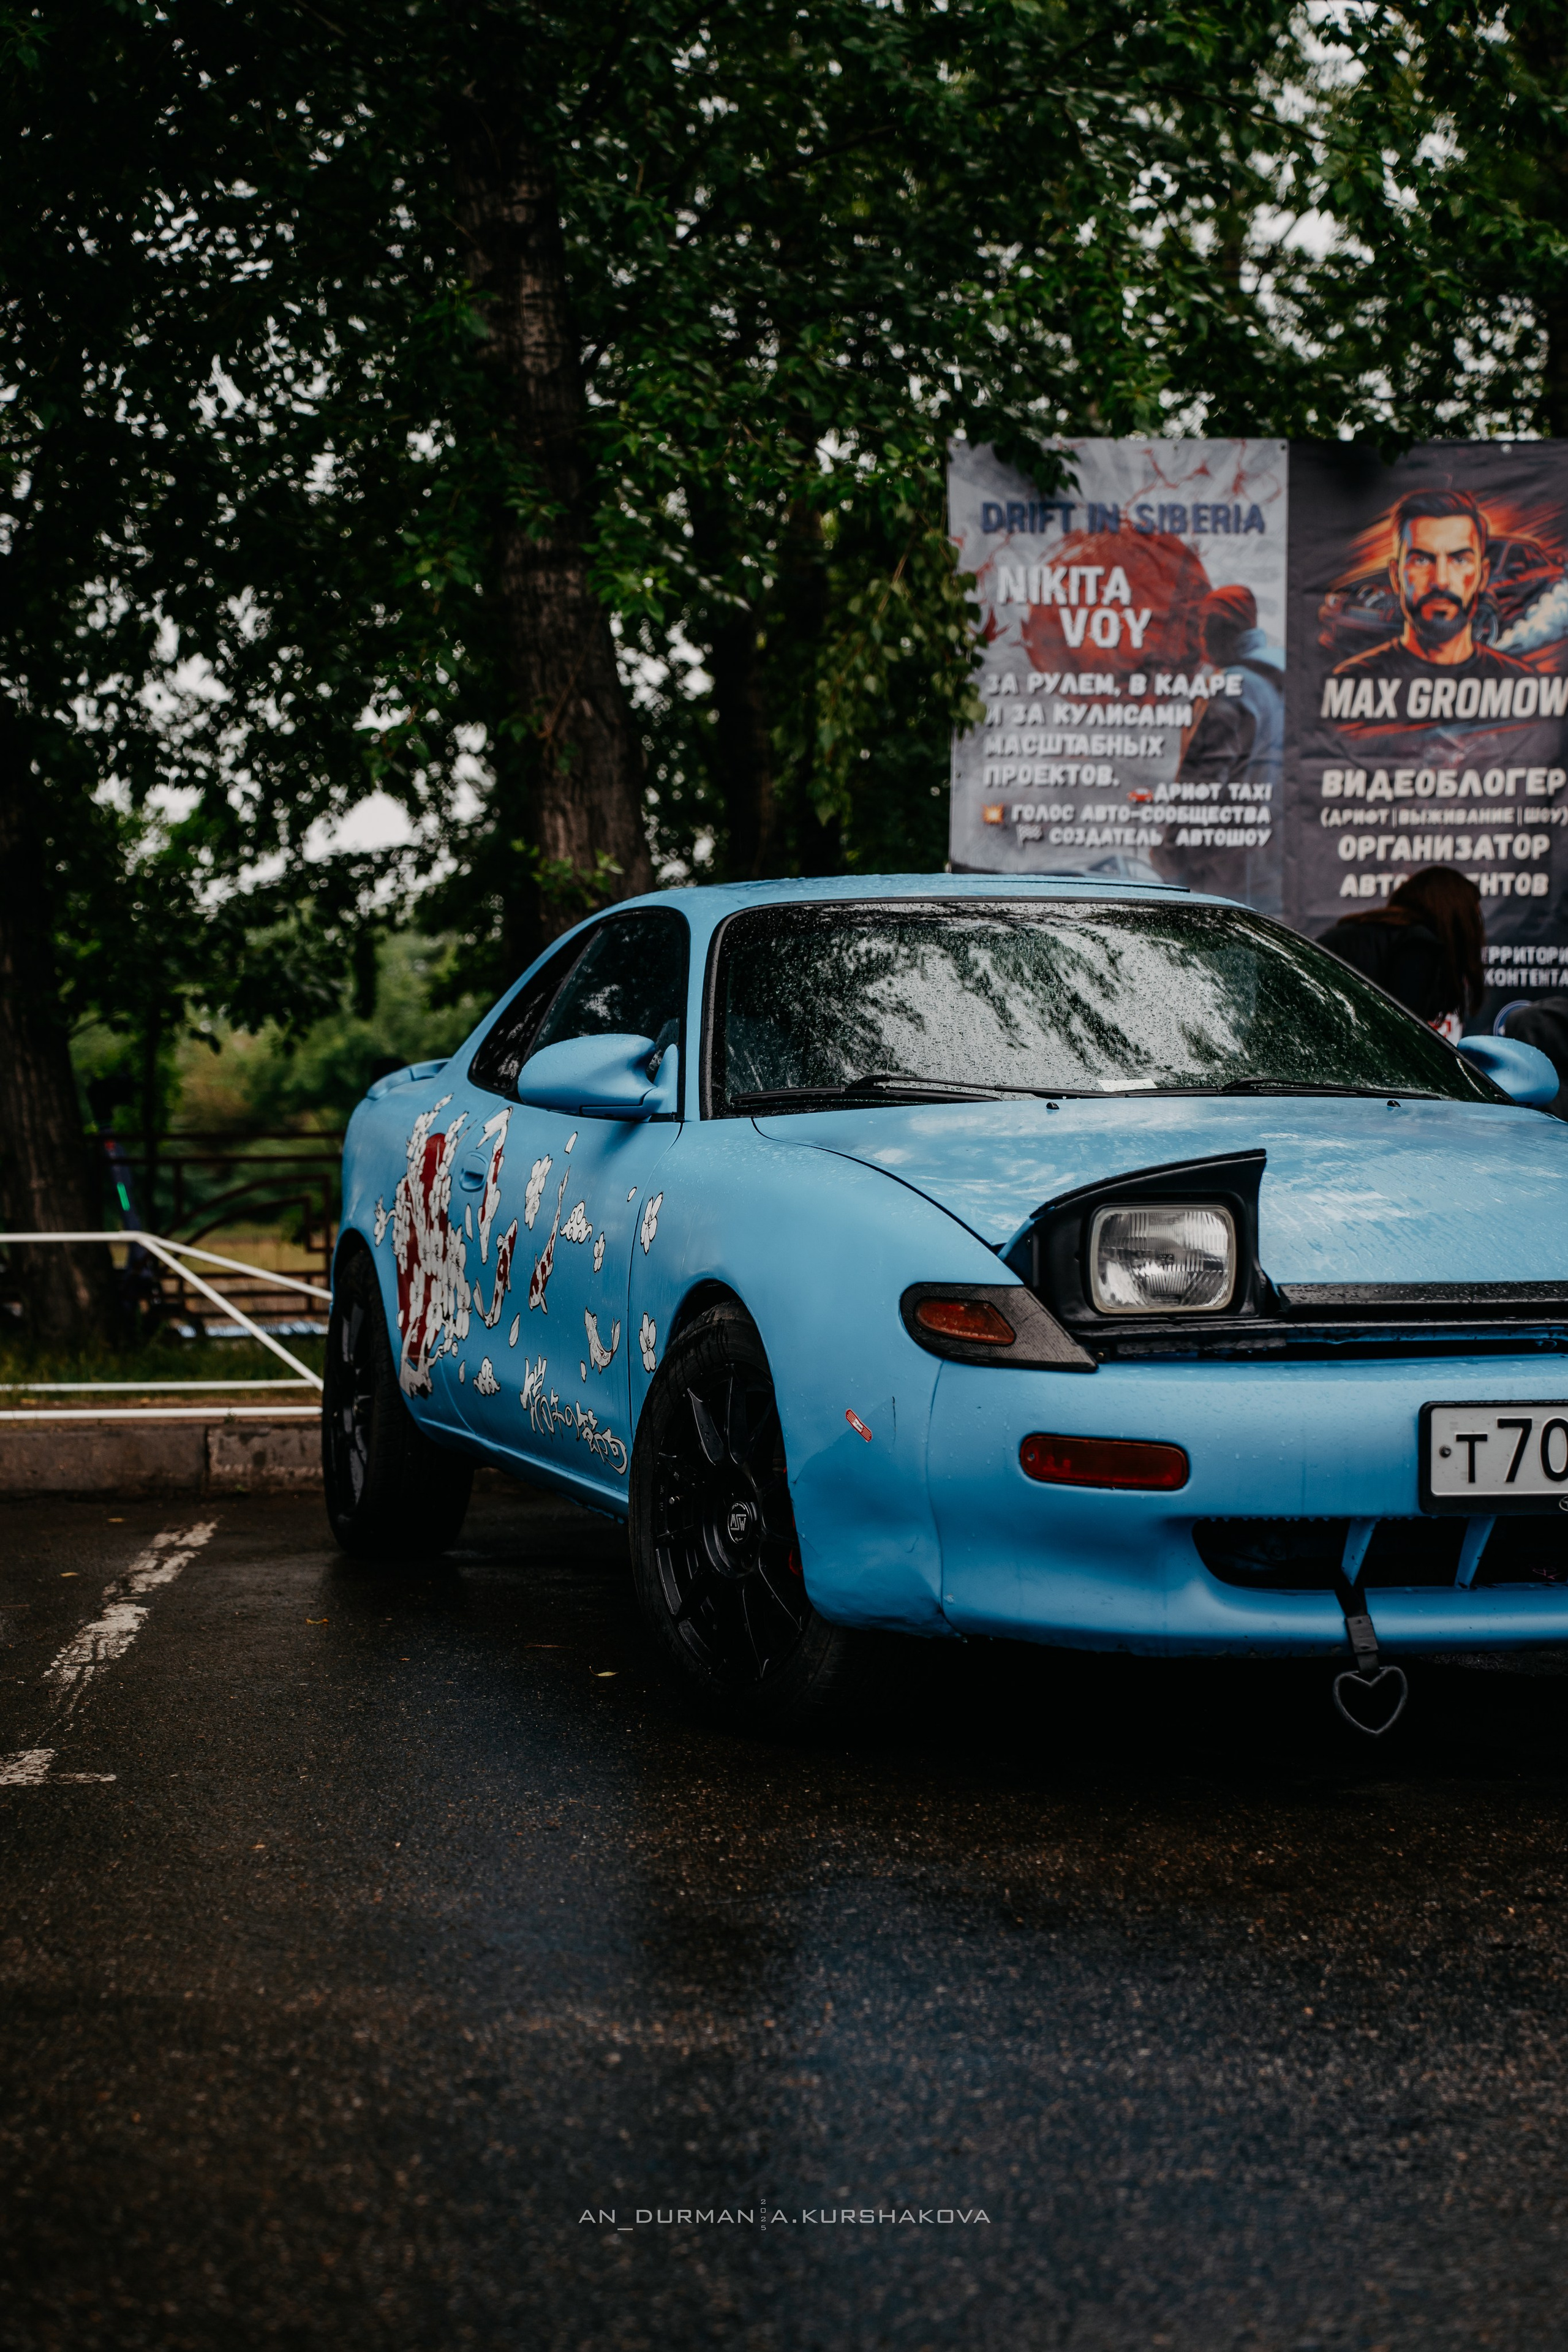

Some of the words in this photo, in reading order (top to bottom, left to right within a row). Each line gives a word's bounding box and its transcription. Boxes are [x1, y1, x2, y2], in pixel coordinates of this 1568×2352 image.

[982, 502, 1076, 533] DRIFT
[1087, 502, 1120, 533] IN
[1136, 503, 1266, 534] SIBERIA
[997, 565, 1131, 605] NIKITA
[1059, 608, 1152, 648] VOY
[987, 674, 1019, 695] ЗА
[1027, 673, 1121, 696] РУЛЕМ,
[1129, 674, 1147, 695] В
[1154, 674, 1242, 699] КАДРЕ
[1321, 677, 1402, 719] MAX
[1406, 676, 1568, 719] GROMOW
[1012, 704, 1045, 726] ЗА
[1052, 703, 1193, 726] КУЛИСАМИ
[985, 735, 1165, 757] МАСШТАБНЫХ
[984, 764, 1120, 786] ПРОЕКТОВ.
[1321, 767, 1566, 802] ВИДЕОБЛОГЕР
[1153, 783, 1221, 803] ДРИФТ
[1011, 804, 1074, 823] ГОЛОС
[1080, 805, 1271, 826] АВТО-СООБЩЕСТВА
[1049, 828, 1163, 846] СОЗДАТЕЛЬ
[1176, 827, 1272, 847] АВТОШОУ
[1338, 834, 1550, 861] ОРГАНИЗАТОР
